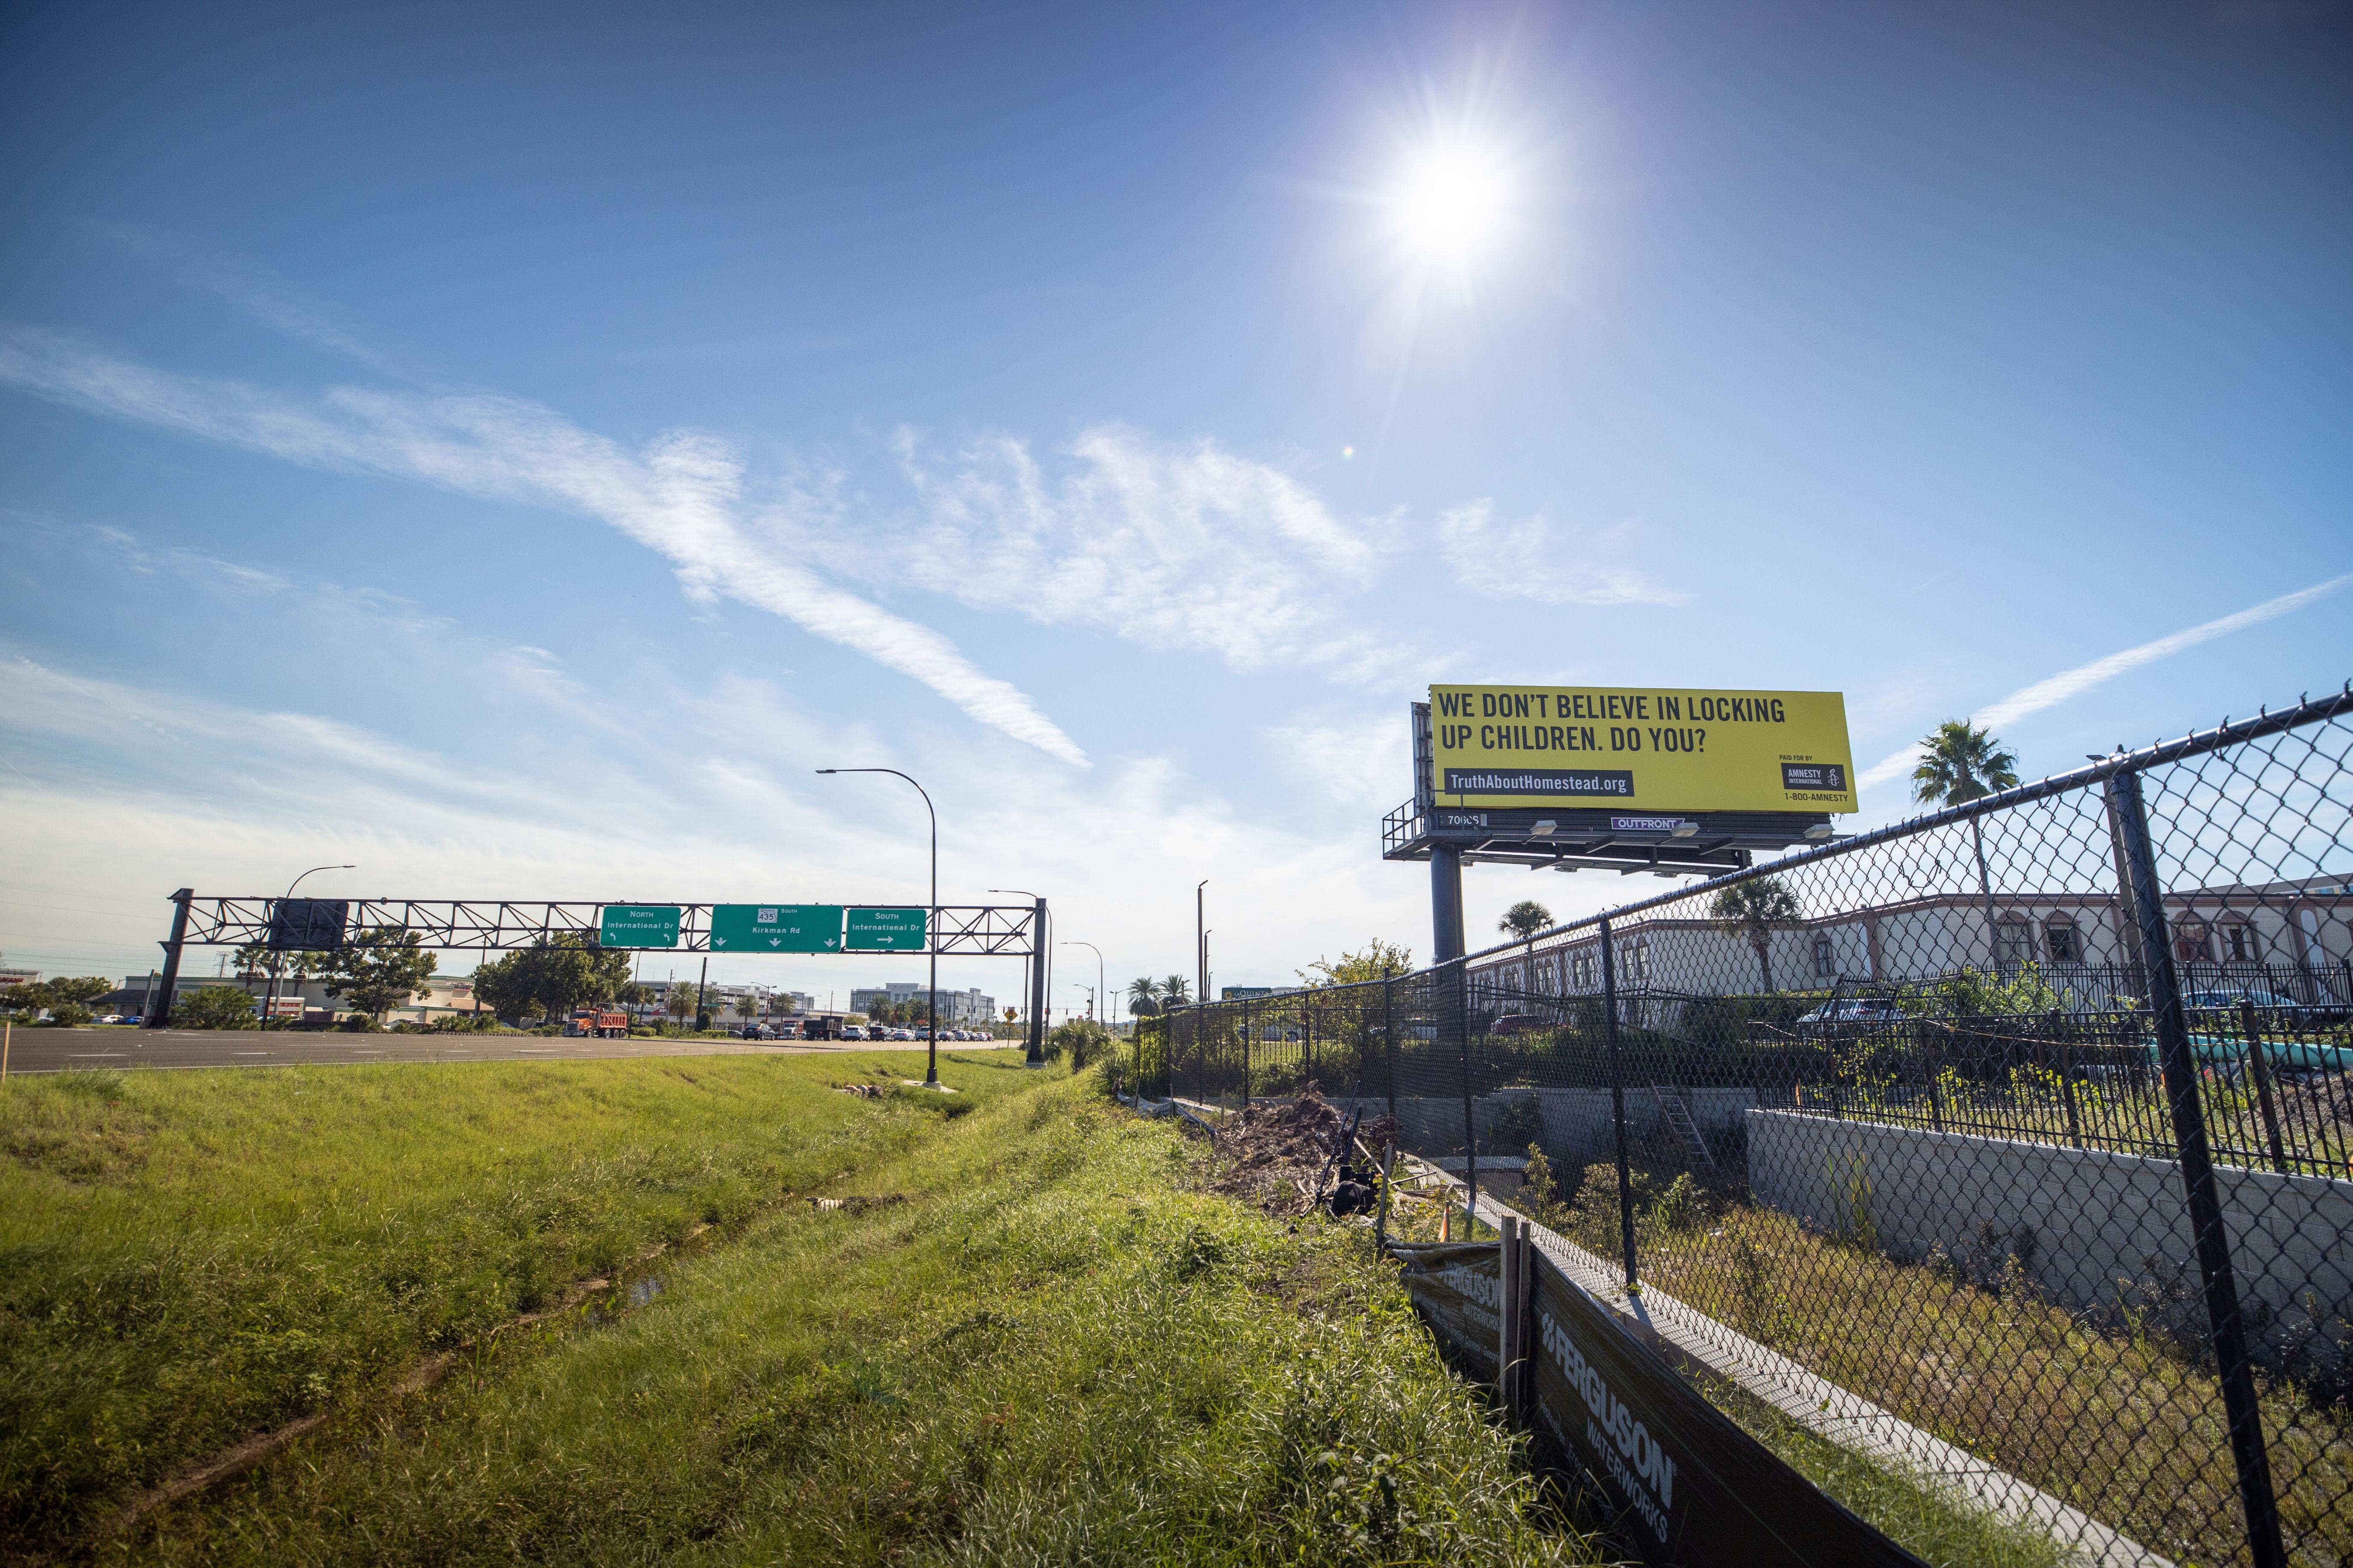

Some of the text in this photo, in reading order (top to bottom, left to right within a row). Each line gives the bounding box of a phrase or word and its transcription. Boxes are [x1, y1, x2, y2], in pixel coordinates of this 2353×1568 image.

[1438, 693, 1785, 722] WE DON’T BELIEVE IN LOCKING
[1441, 725, 1706, 752] UP CHILDREN. DO YOU?
[1451, 774, 1627, 793] TruthAboutHomestead.org
[1788, 769, 1821, 778] AMNESTY
[1784, 793, 1848, 802] 1-800-AMNESTY
[1618, 819, 1677, 828] OUTFRONT
[1463, 1301, 1500, 1332] WATERWORK
[1556, 1326, 1673, 1509] FERGUSON
[1587, 1416, 1668, 1543] WATERWORKS
